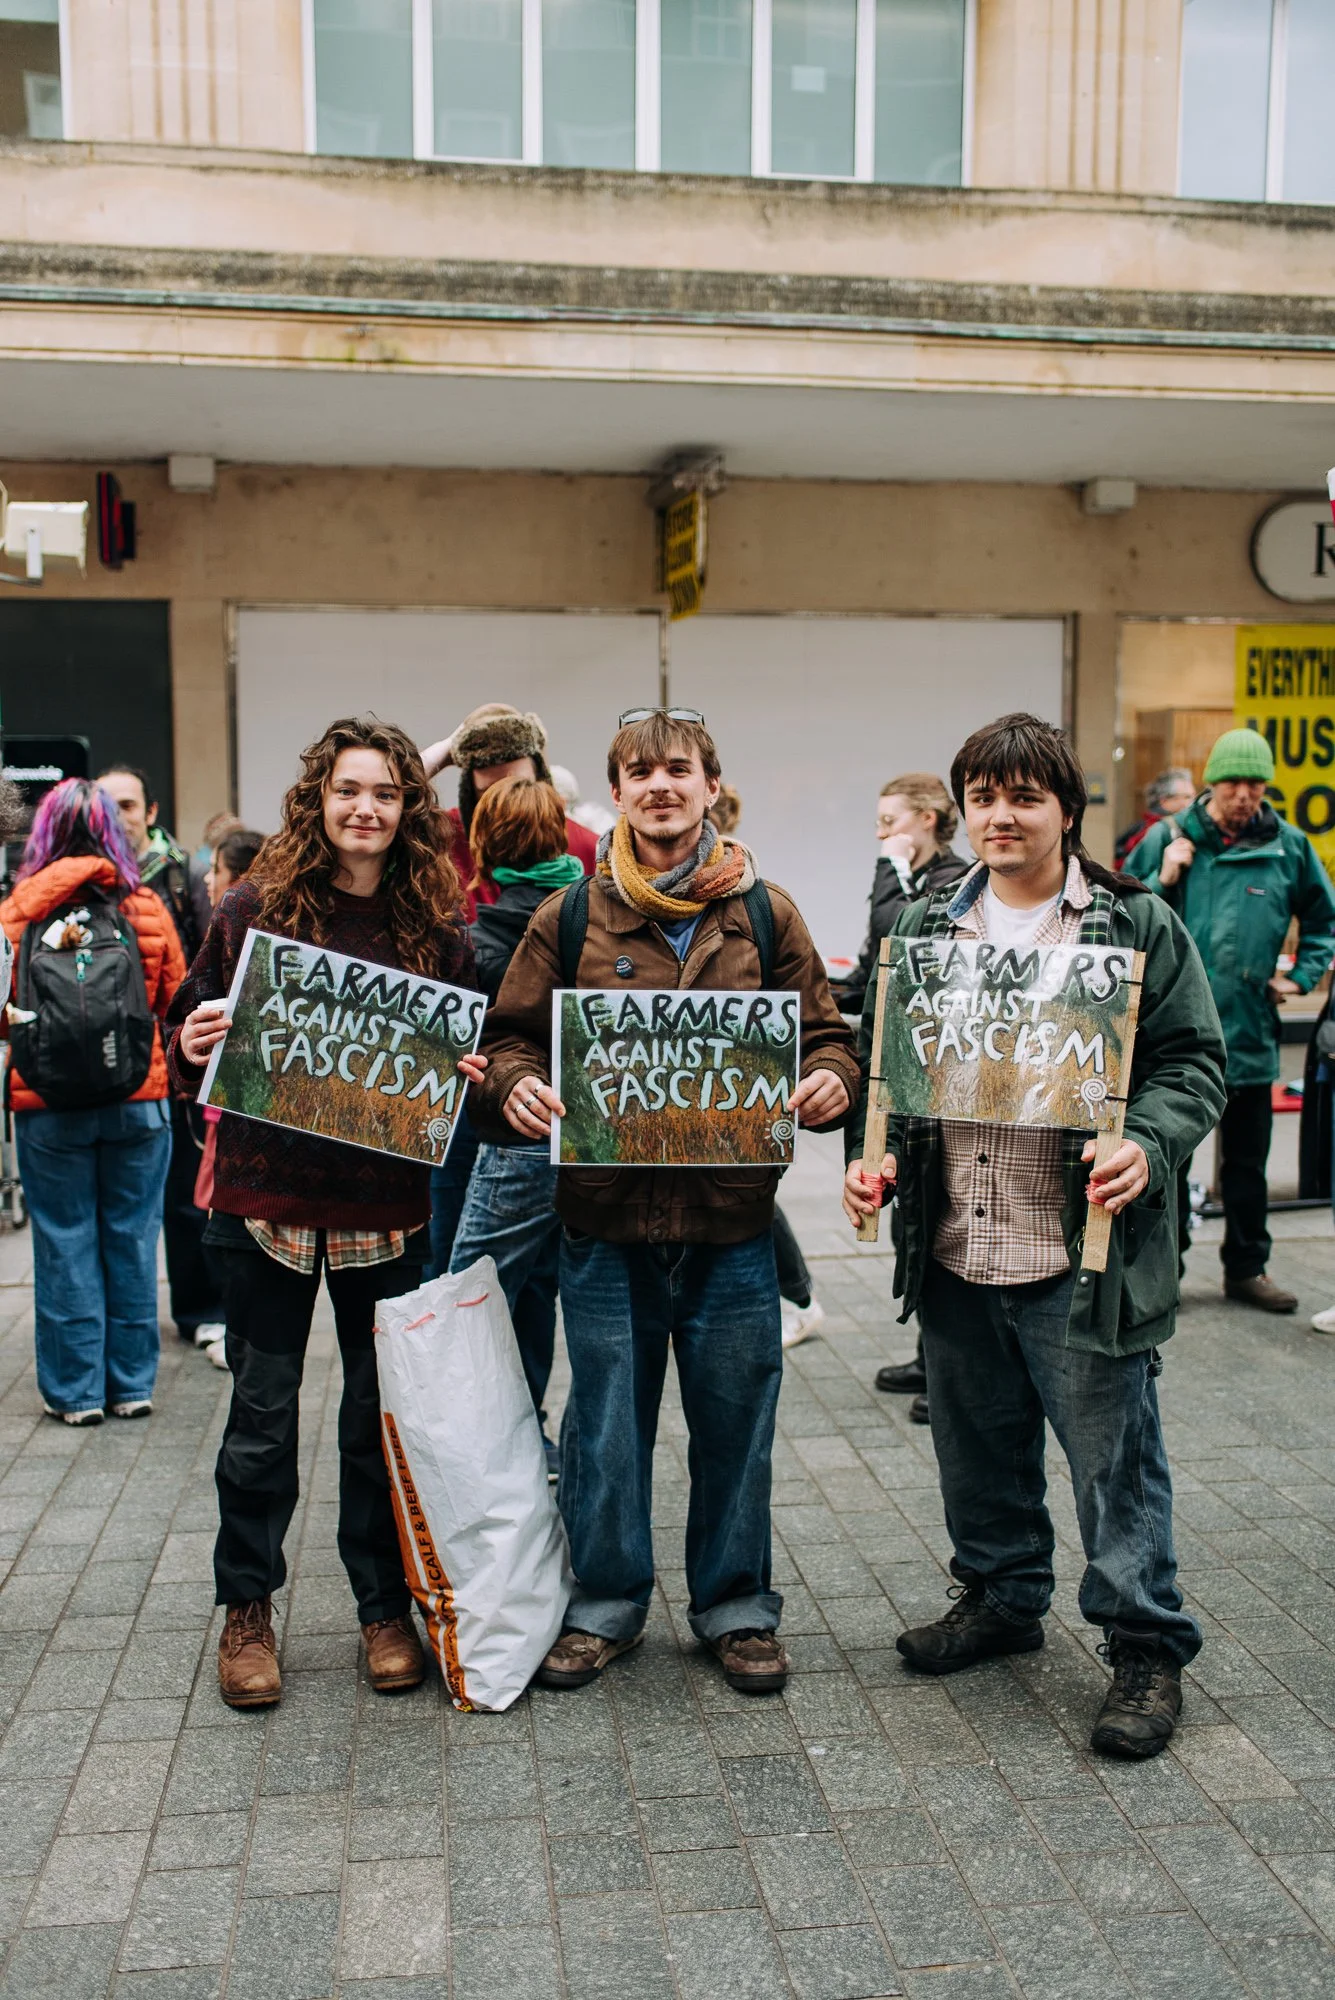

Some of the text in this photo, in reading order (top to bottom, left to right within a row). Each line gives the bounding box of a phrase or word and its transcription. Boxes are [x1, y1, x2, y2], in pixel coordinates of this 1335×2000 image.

[272, 945, 484, 1047] FARMERS
[908, 941, 1128, 1004] FARMRS
[258, 990, 417, 1052] AGAINST
[580, 993, 797, 1048] FARMERS
[905, 988, 1055, 1022] AGAINST
[259, 1028, 459, 1115] FASCISM
[582, 1036, 735, 1070] AGAINST
[910, 1016, 1105, 1074] FASCISM
[589, 1067, 793, 1120] FASCISM
[400, 1475, 421, 1516] BEEF
[415, 1520, 426, 1532] &
[418, 1538, 442, 1581] CALF
